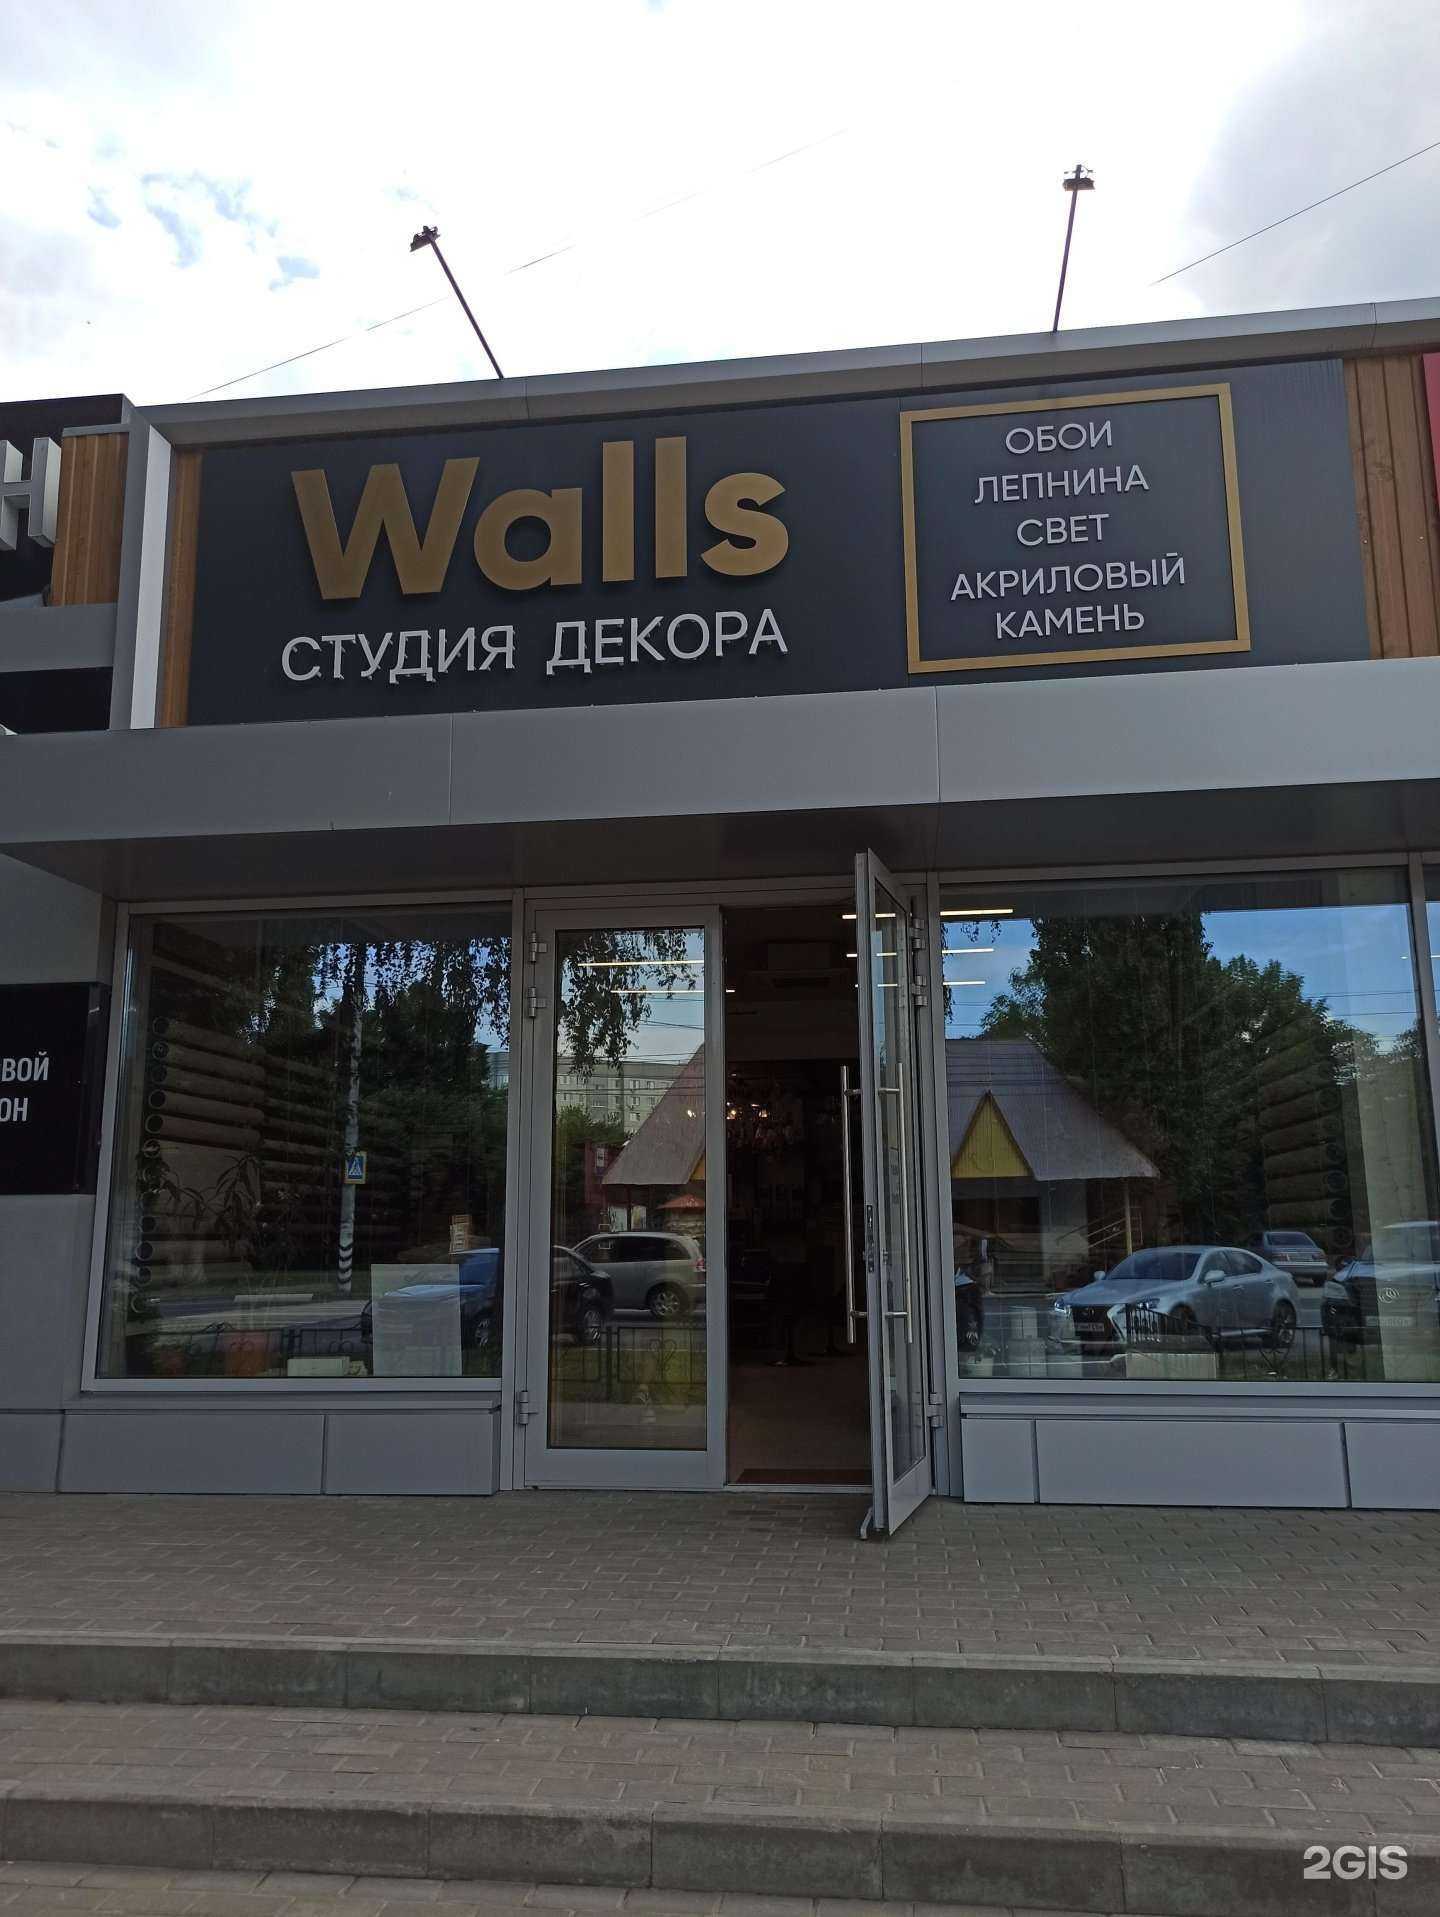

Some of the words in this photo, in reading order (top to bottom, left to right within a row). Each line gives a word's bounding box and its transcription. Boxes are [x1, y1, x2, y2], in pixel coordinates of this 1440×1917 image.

[1005, 420, 1113, 454] ОБОИ
[974, 464, 1150, 504] ЛЕПНИНА
[291, 436, 789, 600] Walls
[1016, 513, 1110, 546] СВЕТ
[950, 552, 1186, 601] АКРИЛОВЫЙ
[996, 603, 1145, 639] КАМЕНЬ
[281, 625, 516, 685] СТУДИЯ
[545, 608, 789, 676] ДЕКОРА
